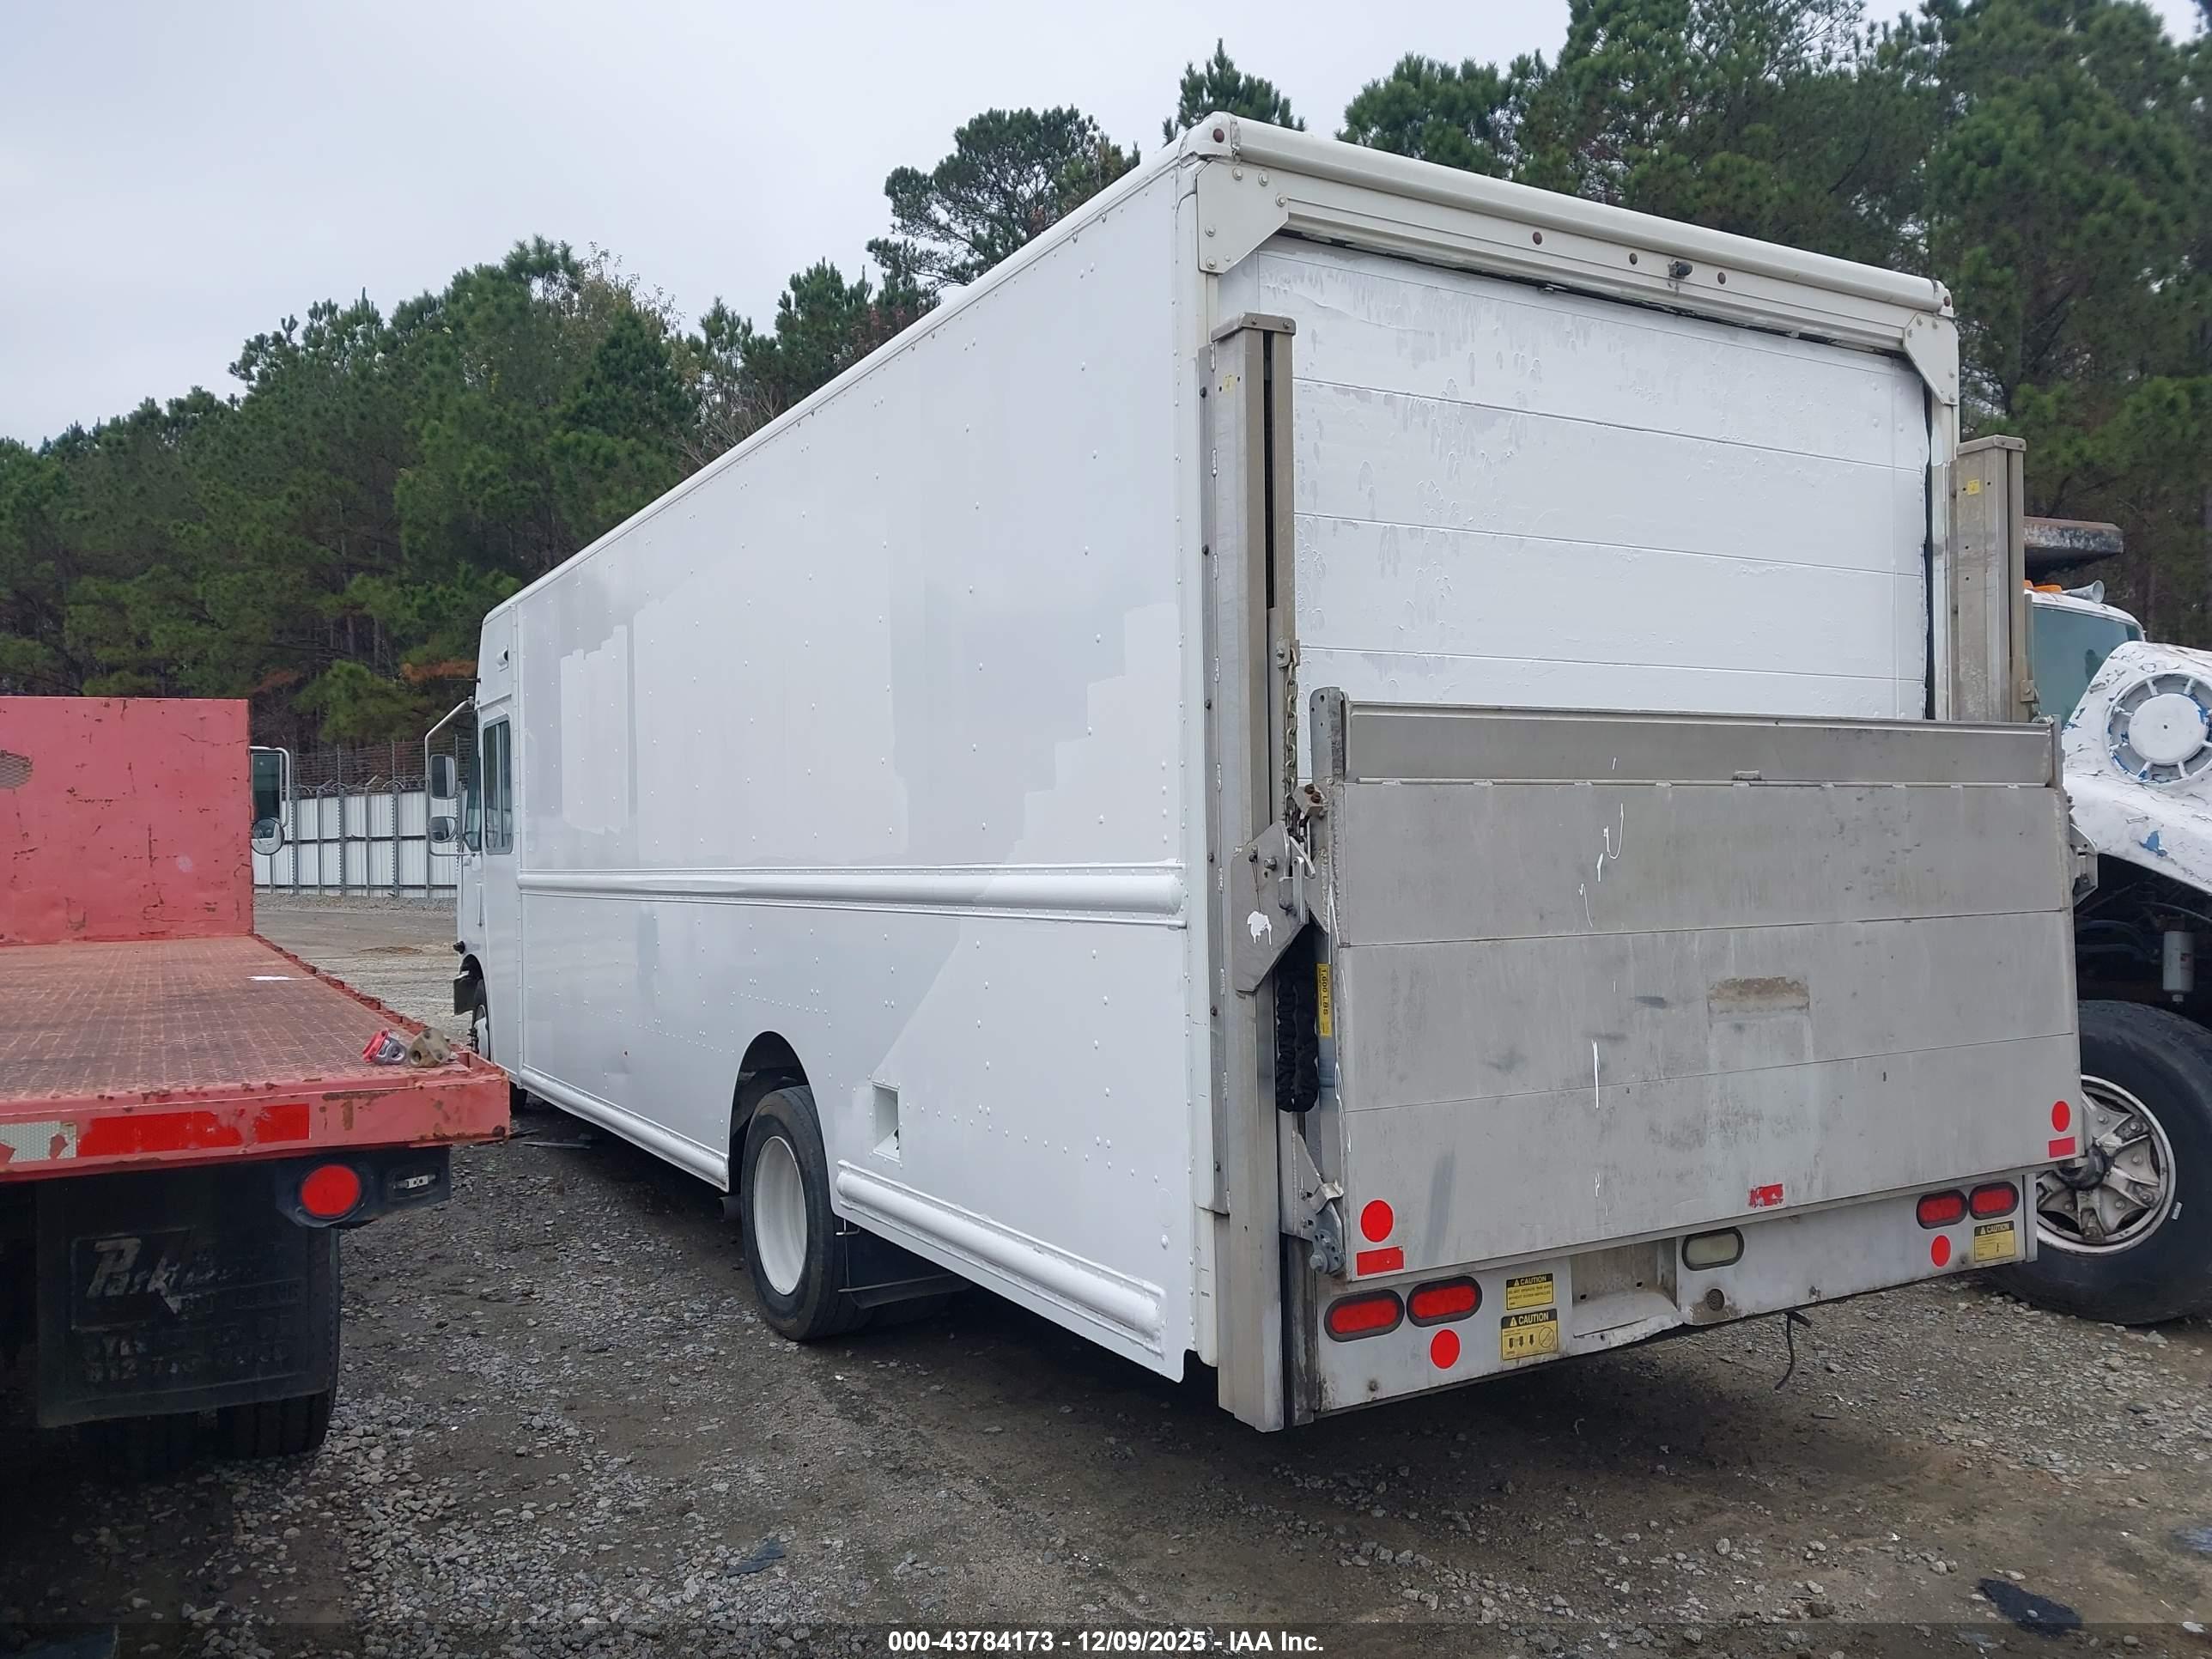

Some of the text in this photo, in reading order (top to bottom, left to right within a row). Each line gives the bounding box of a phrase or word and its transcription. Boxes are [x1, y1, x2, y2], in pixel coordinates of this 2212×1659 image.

[1986, 1223, 2009, 1234] CAUTION
[1520, 1275, 1547, 1285] CAUTION
[1518, 1312, 1549, 1325] CAUTION
